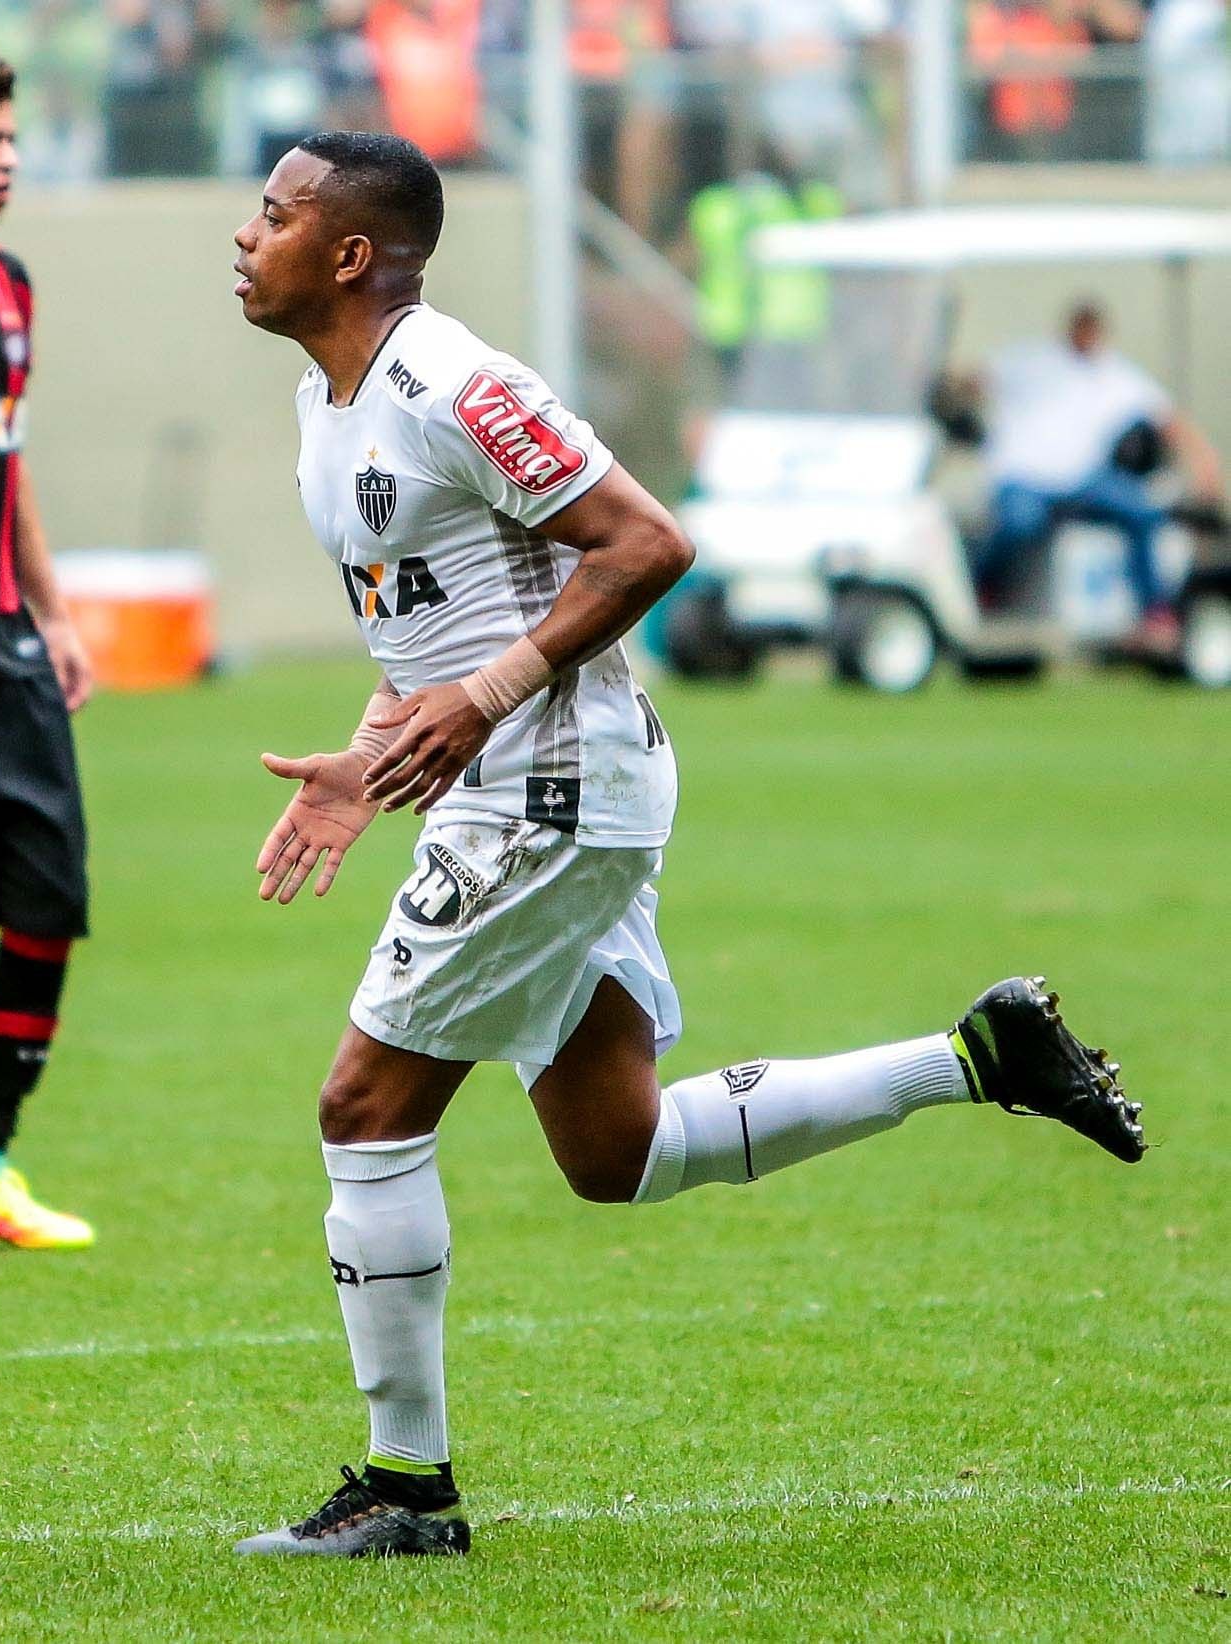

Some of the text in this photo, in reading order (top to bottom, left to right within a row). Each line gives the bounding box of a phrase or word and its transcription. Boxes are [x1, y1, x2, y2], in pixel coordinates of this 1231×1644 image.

[386, 358, 429, 399] MRV
[462, 377, 563, 485] Vilma
[471, 423, 536, 489] ALIMENTOS
[361, 479, 390, 491] CAM
[341, 556, 450, 618] IXA
[431, 843, 481, 893] MERCADOS
